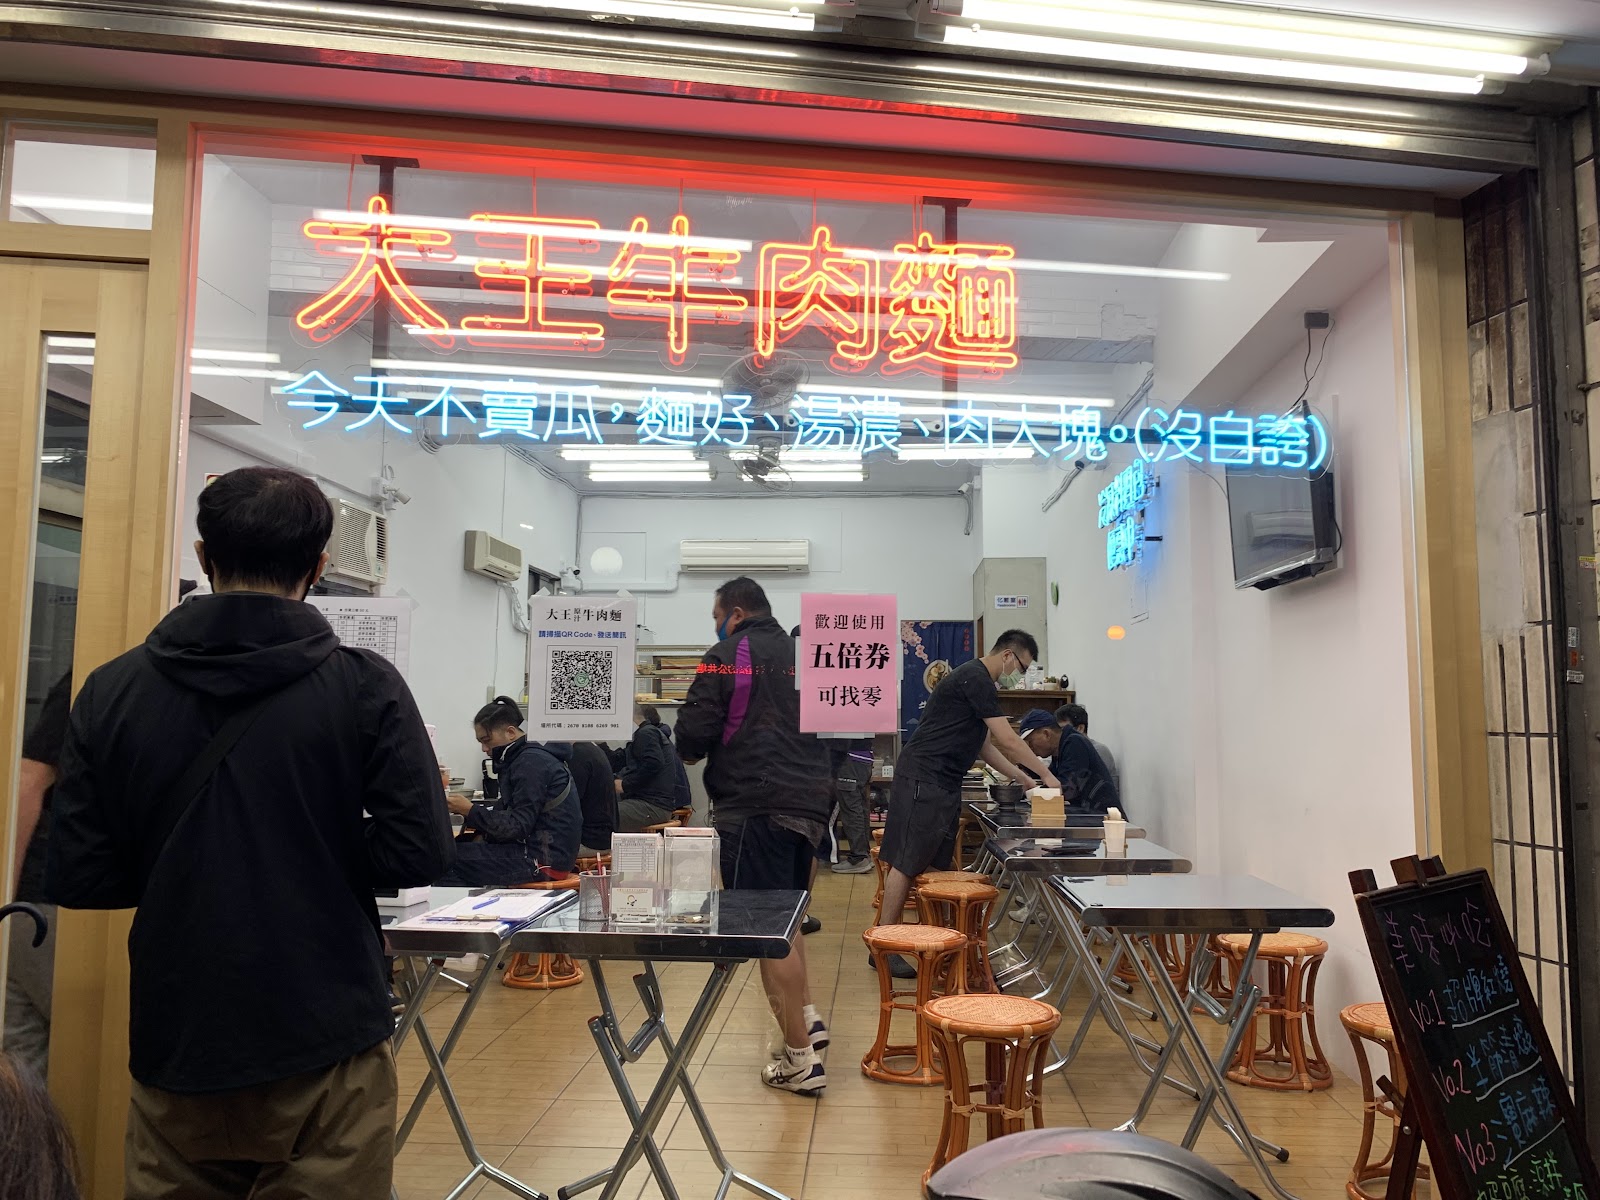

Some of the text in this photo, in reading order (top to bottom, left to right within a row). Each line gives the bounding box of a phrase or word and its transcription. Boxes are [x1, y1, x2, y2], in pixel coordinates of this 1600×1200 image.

[296, 195, 1018, 369] 大王牛肉麵
[814, 614, 885, 630] 歡迎使用
[809, 642, 890, 670] 五倍券
[817, 685, 882, 707] 可找零
[1454, 1122, 1497, 1175] No.3
